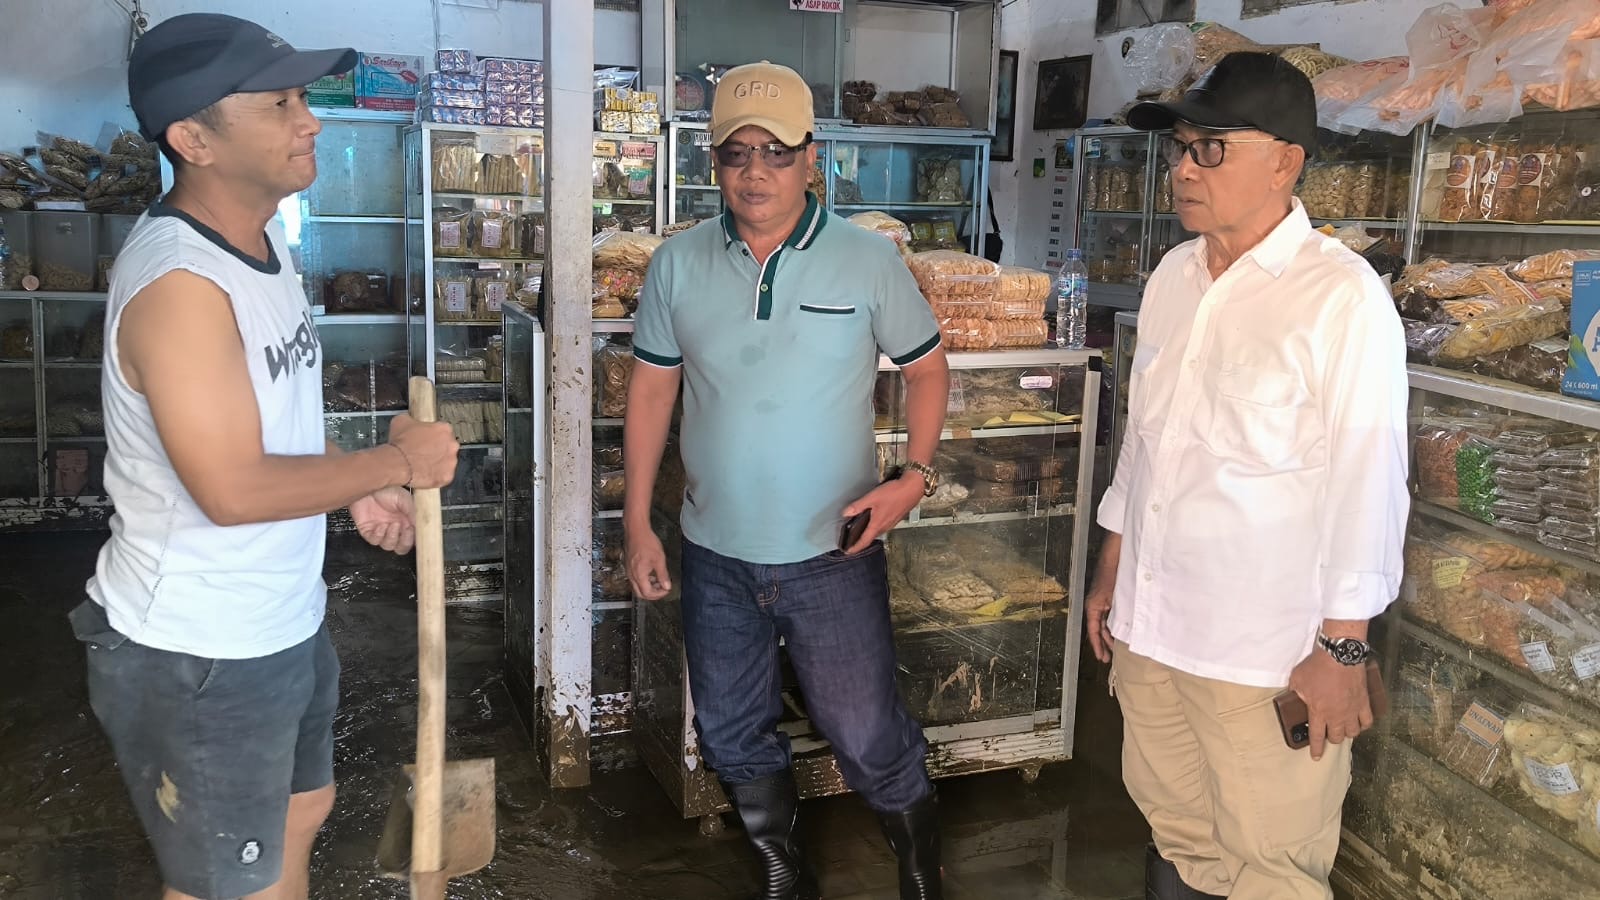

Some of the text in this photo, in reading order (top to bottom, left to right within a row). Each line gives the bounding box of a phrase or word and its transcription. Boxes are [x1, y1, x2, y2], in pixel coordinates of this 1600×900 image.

[805, 1, 840, 10] ASAP ROKOK
[734, 80, 781, 99] GRD
[1564, 380, 1573, 388] 24
[1577, 381, 1590, 390] 600
